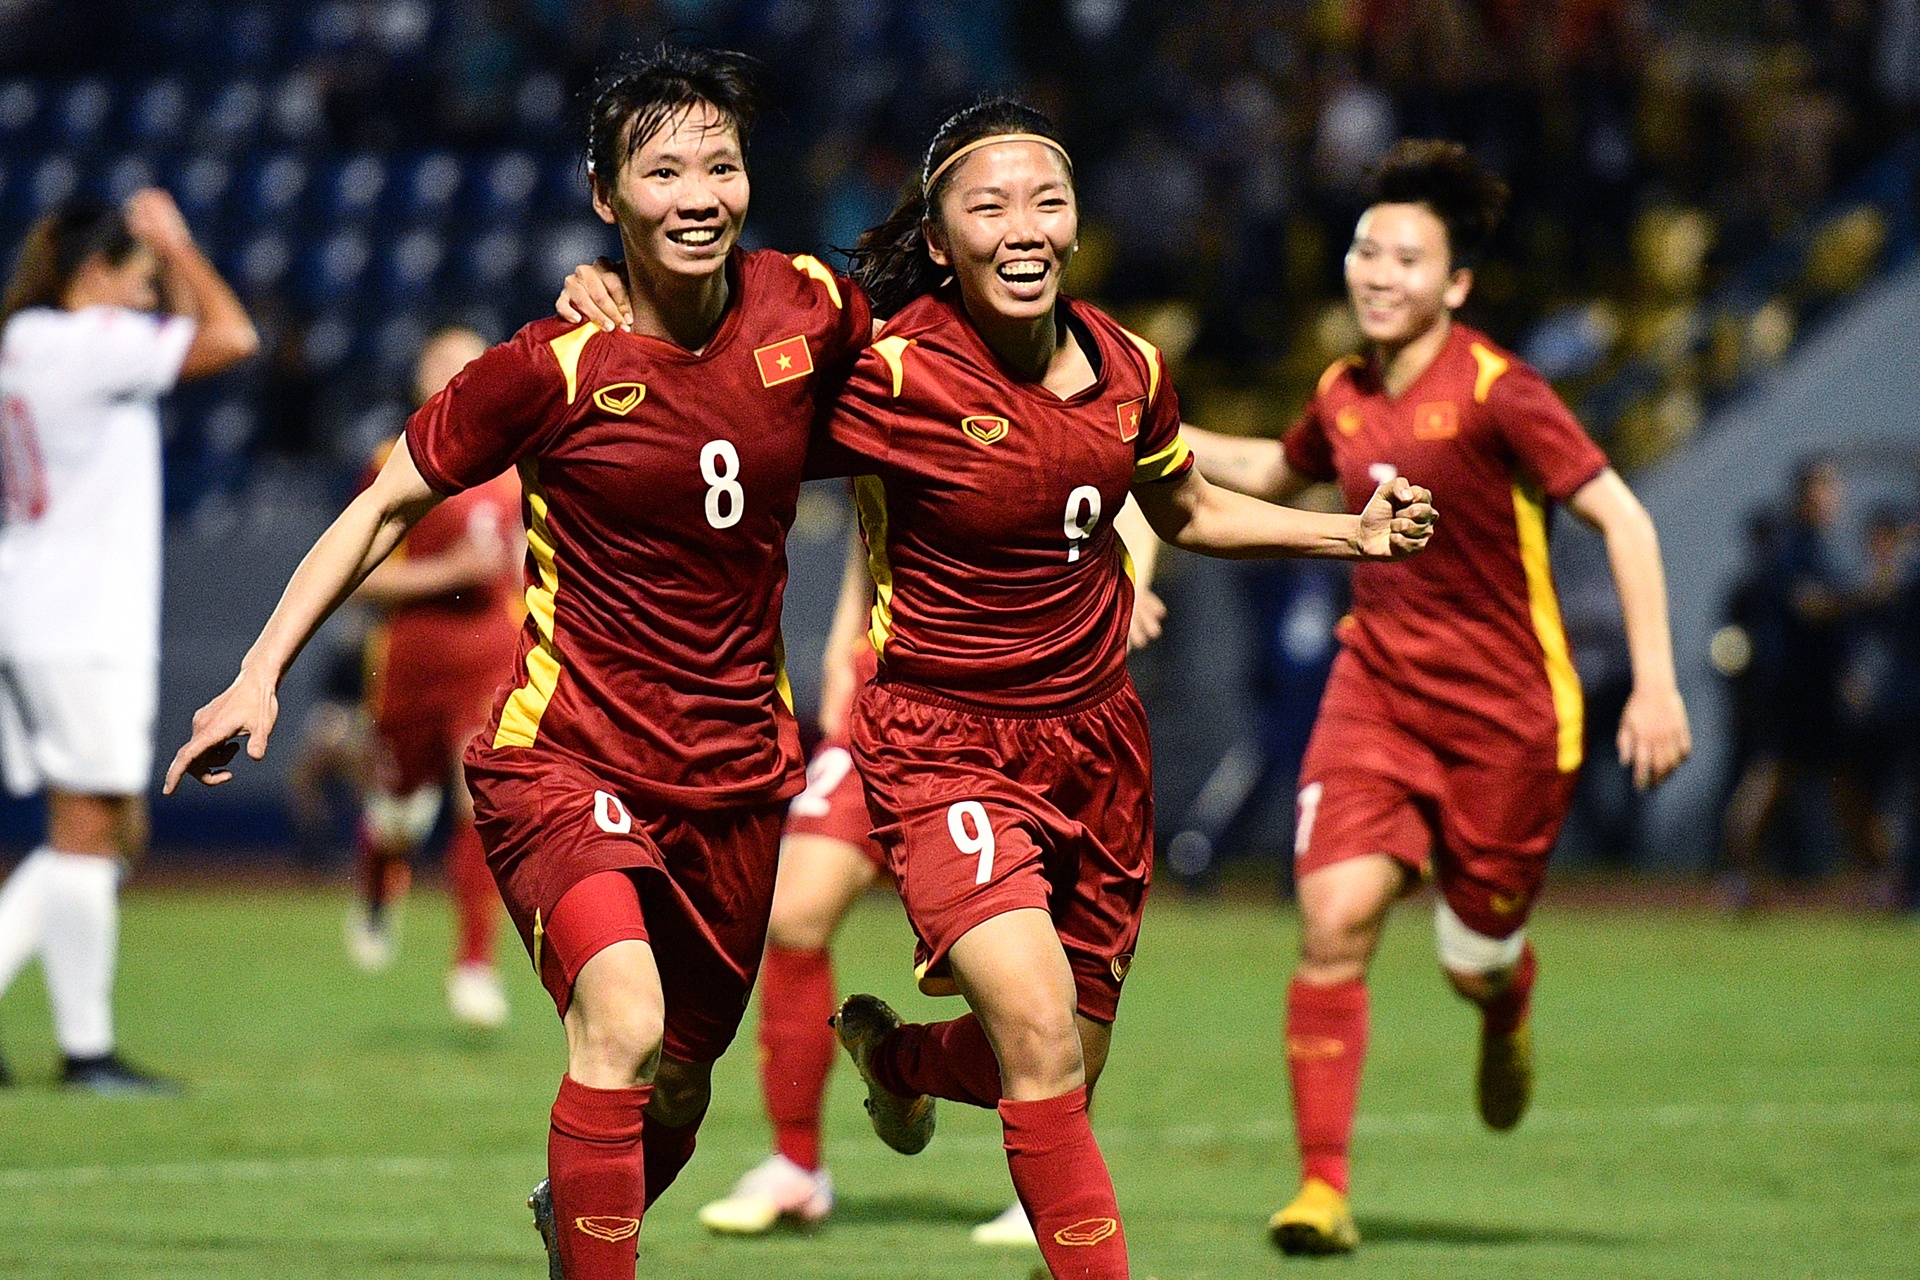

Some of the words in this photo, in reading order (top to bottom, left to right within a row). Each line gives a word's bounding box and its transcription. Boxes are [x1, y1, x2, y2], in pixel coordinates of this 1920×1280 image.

[699, 439, 744, 529] 8
[1064, 485, 1101, 563] 9
[947, 800, 996, 885] 9
